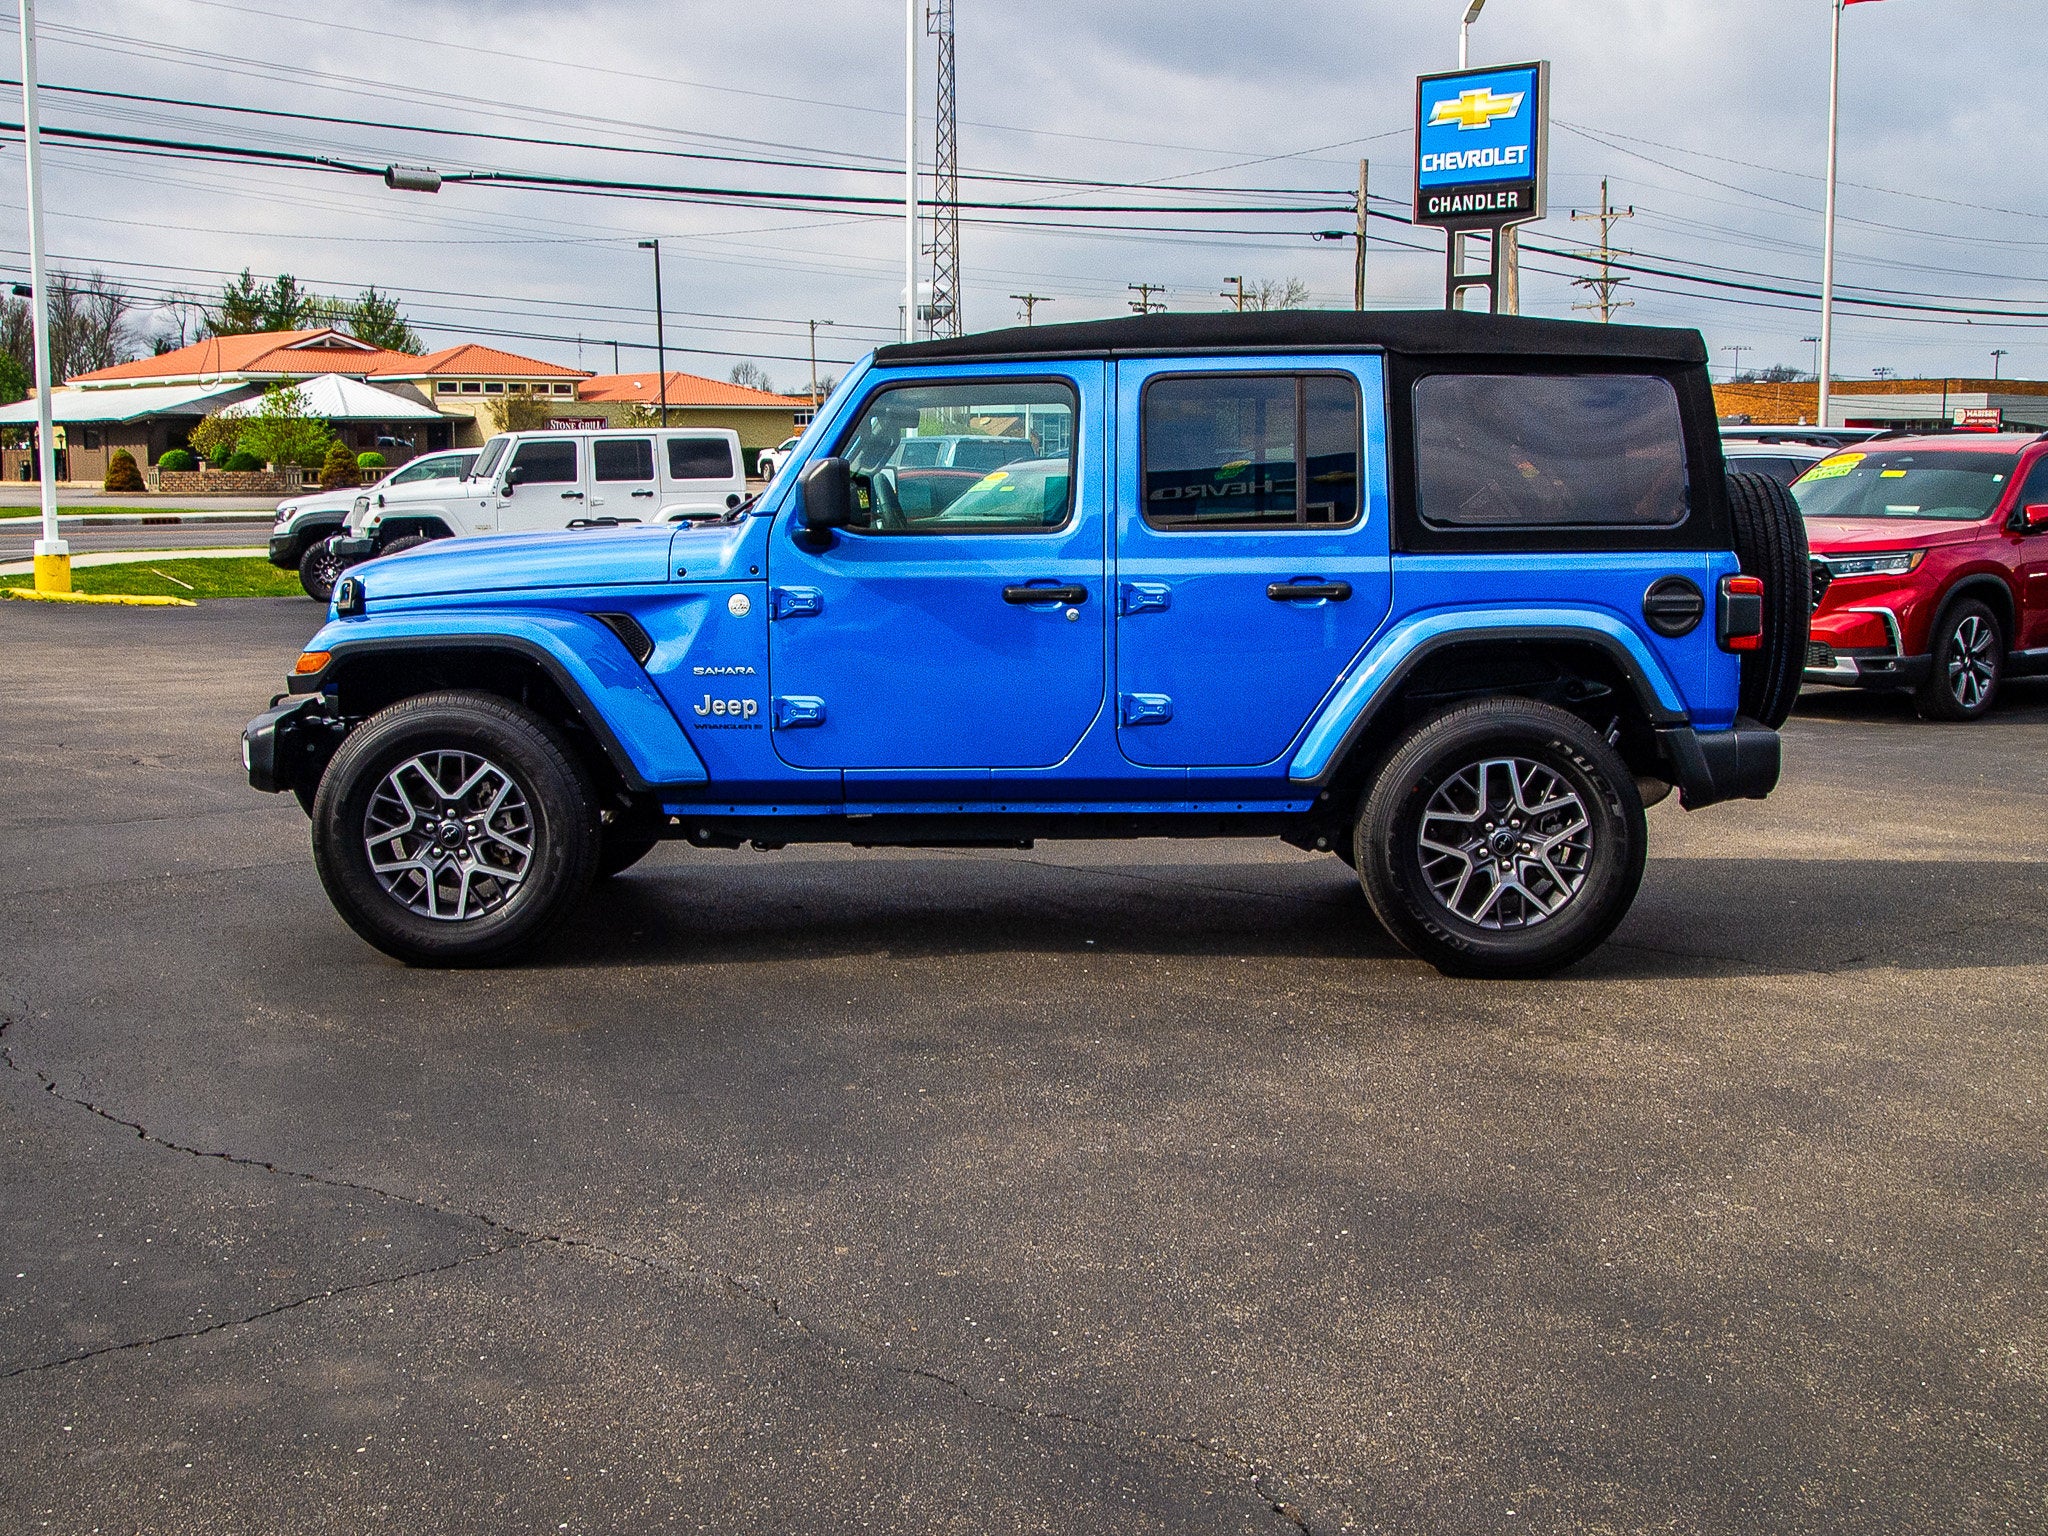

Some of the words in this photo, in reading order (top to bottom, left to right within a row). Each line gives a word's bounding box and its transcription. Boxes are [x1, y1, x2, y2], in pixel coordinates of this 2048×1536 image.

[1421, 146, 1528, 172] CHEVROLET
[1428, 191, 1519, 213] CHANDLER
[550, 419, 577, 430] STONE
[693, 666, 757, 675] SAHARA
[693, 694, 758, 720] Jeep
